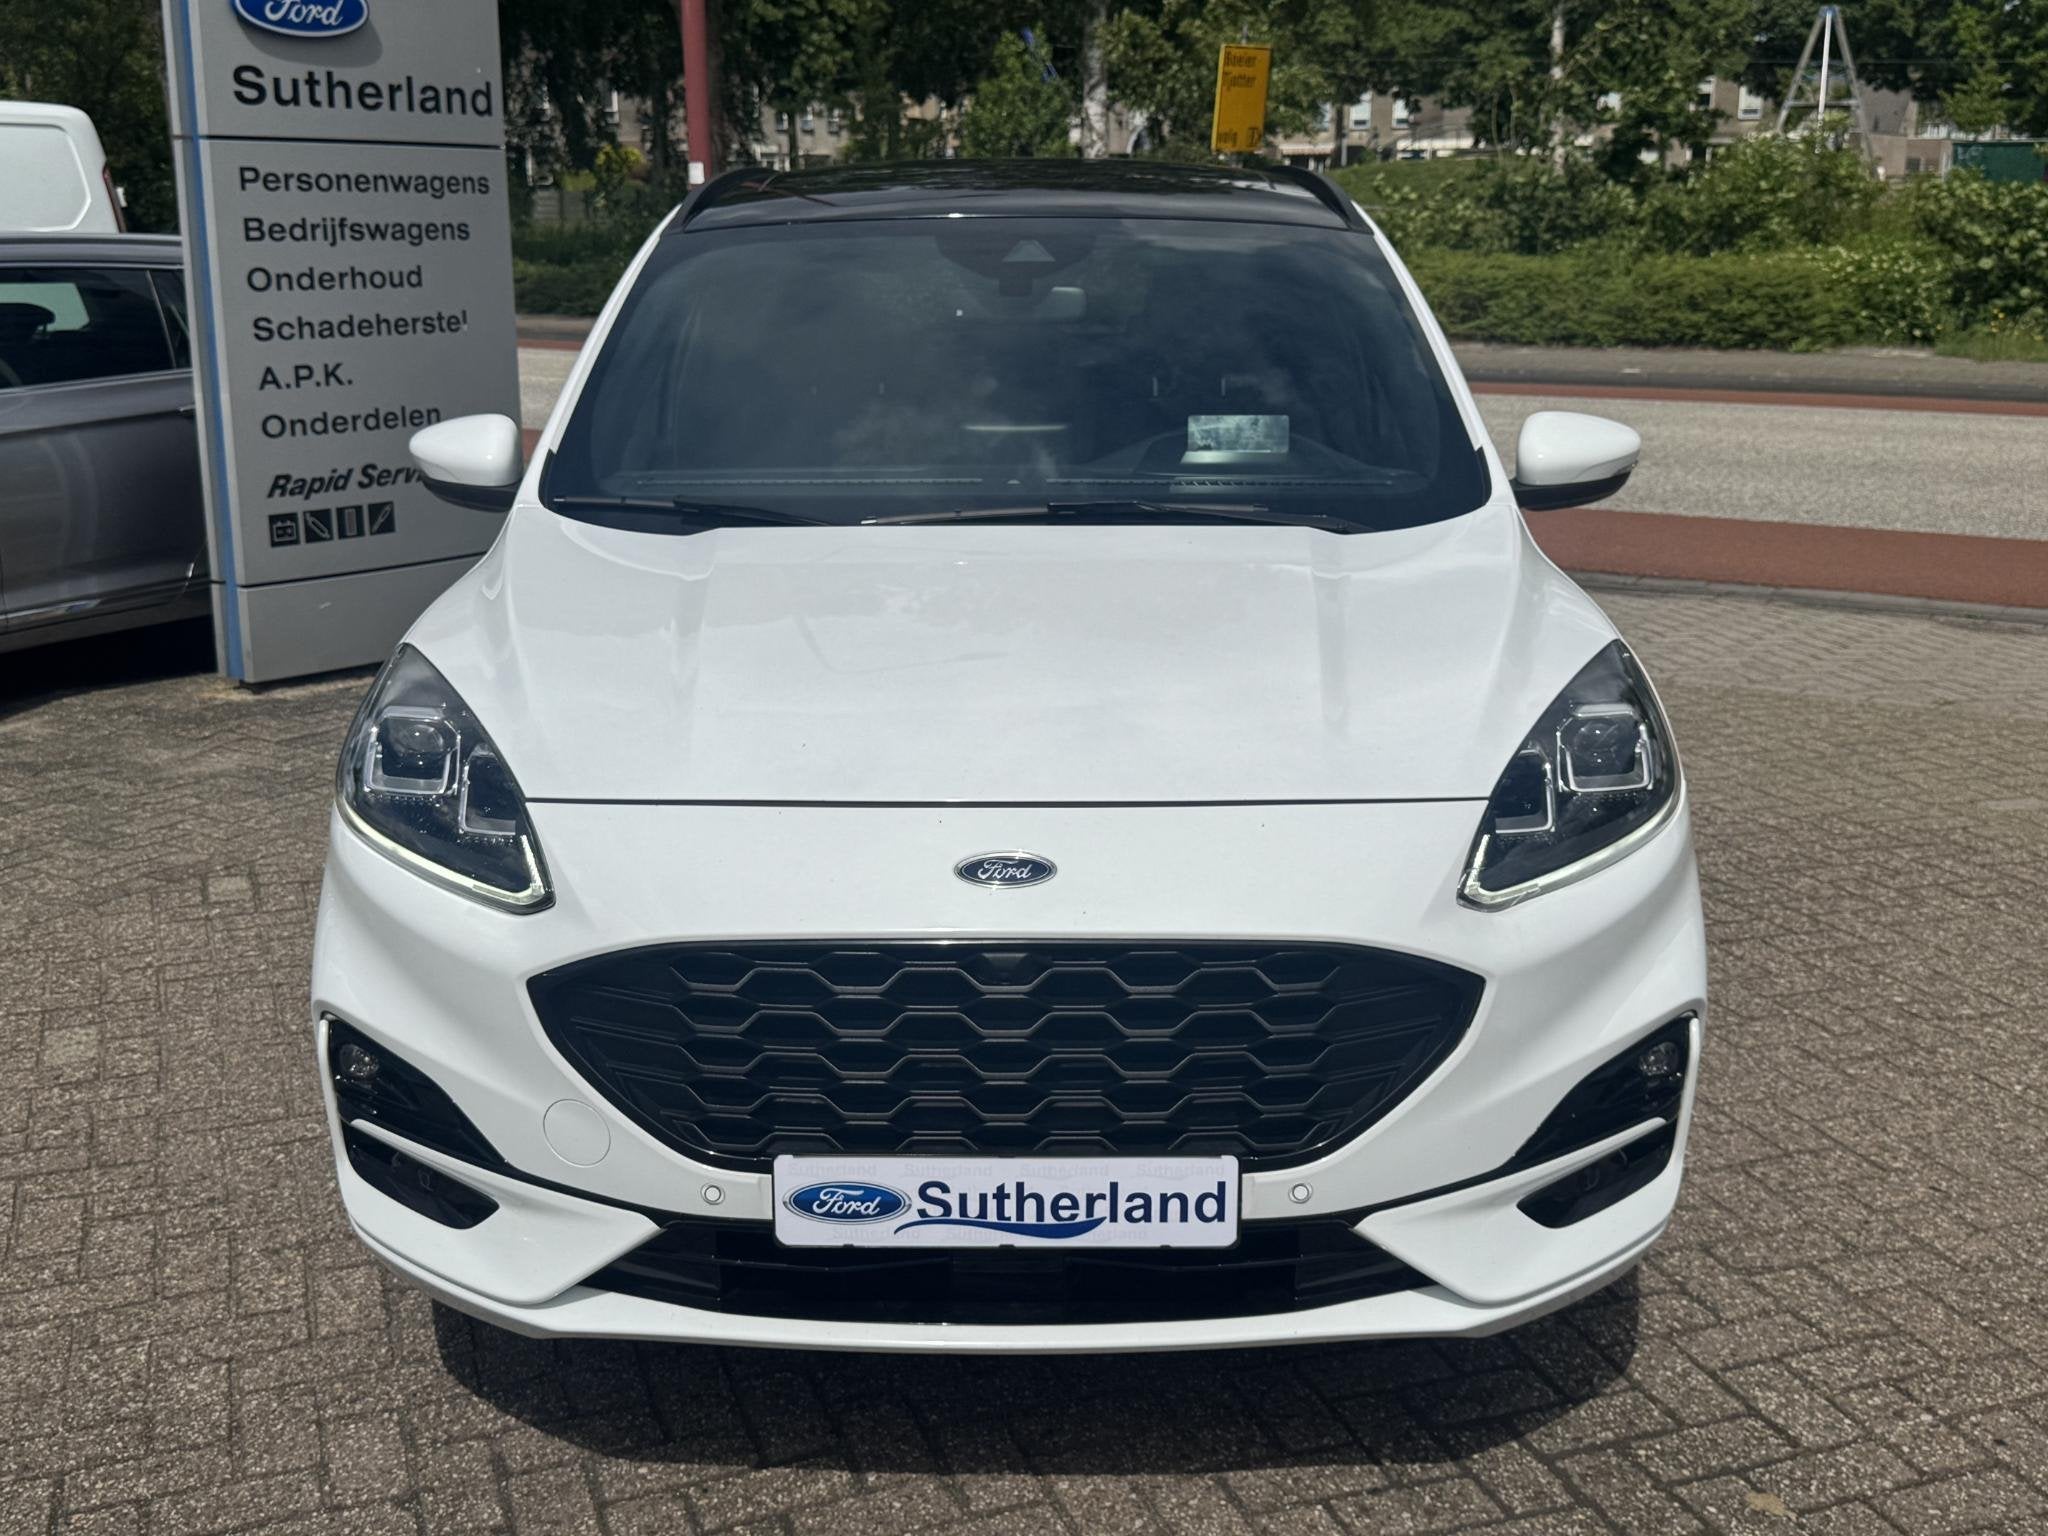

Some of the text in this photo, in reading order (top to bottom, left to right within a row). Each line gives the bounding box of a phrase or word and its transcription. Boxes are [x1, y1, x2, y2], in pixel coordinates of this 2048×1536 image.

[264, 0, 343, 26] Ford
[233, 65, 493, 117] Sutherland
[239, 166, 490, 199] Personenwagens
[243, 217, 470, 246] Bedrijfswagens
[247, 265, 423, 292] Onderhoud
[253, 310, 467, 341] Schadeherstel
[259, 363, 353, 390] A.P.K.
[262, 406, 441, 438] Onderdelen
[267, 468, 353, 500] Rapid
[977, 859, 1033, 880] Ford
[812, 1181, 1226, 1223] Ford Sutherland
